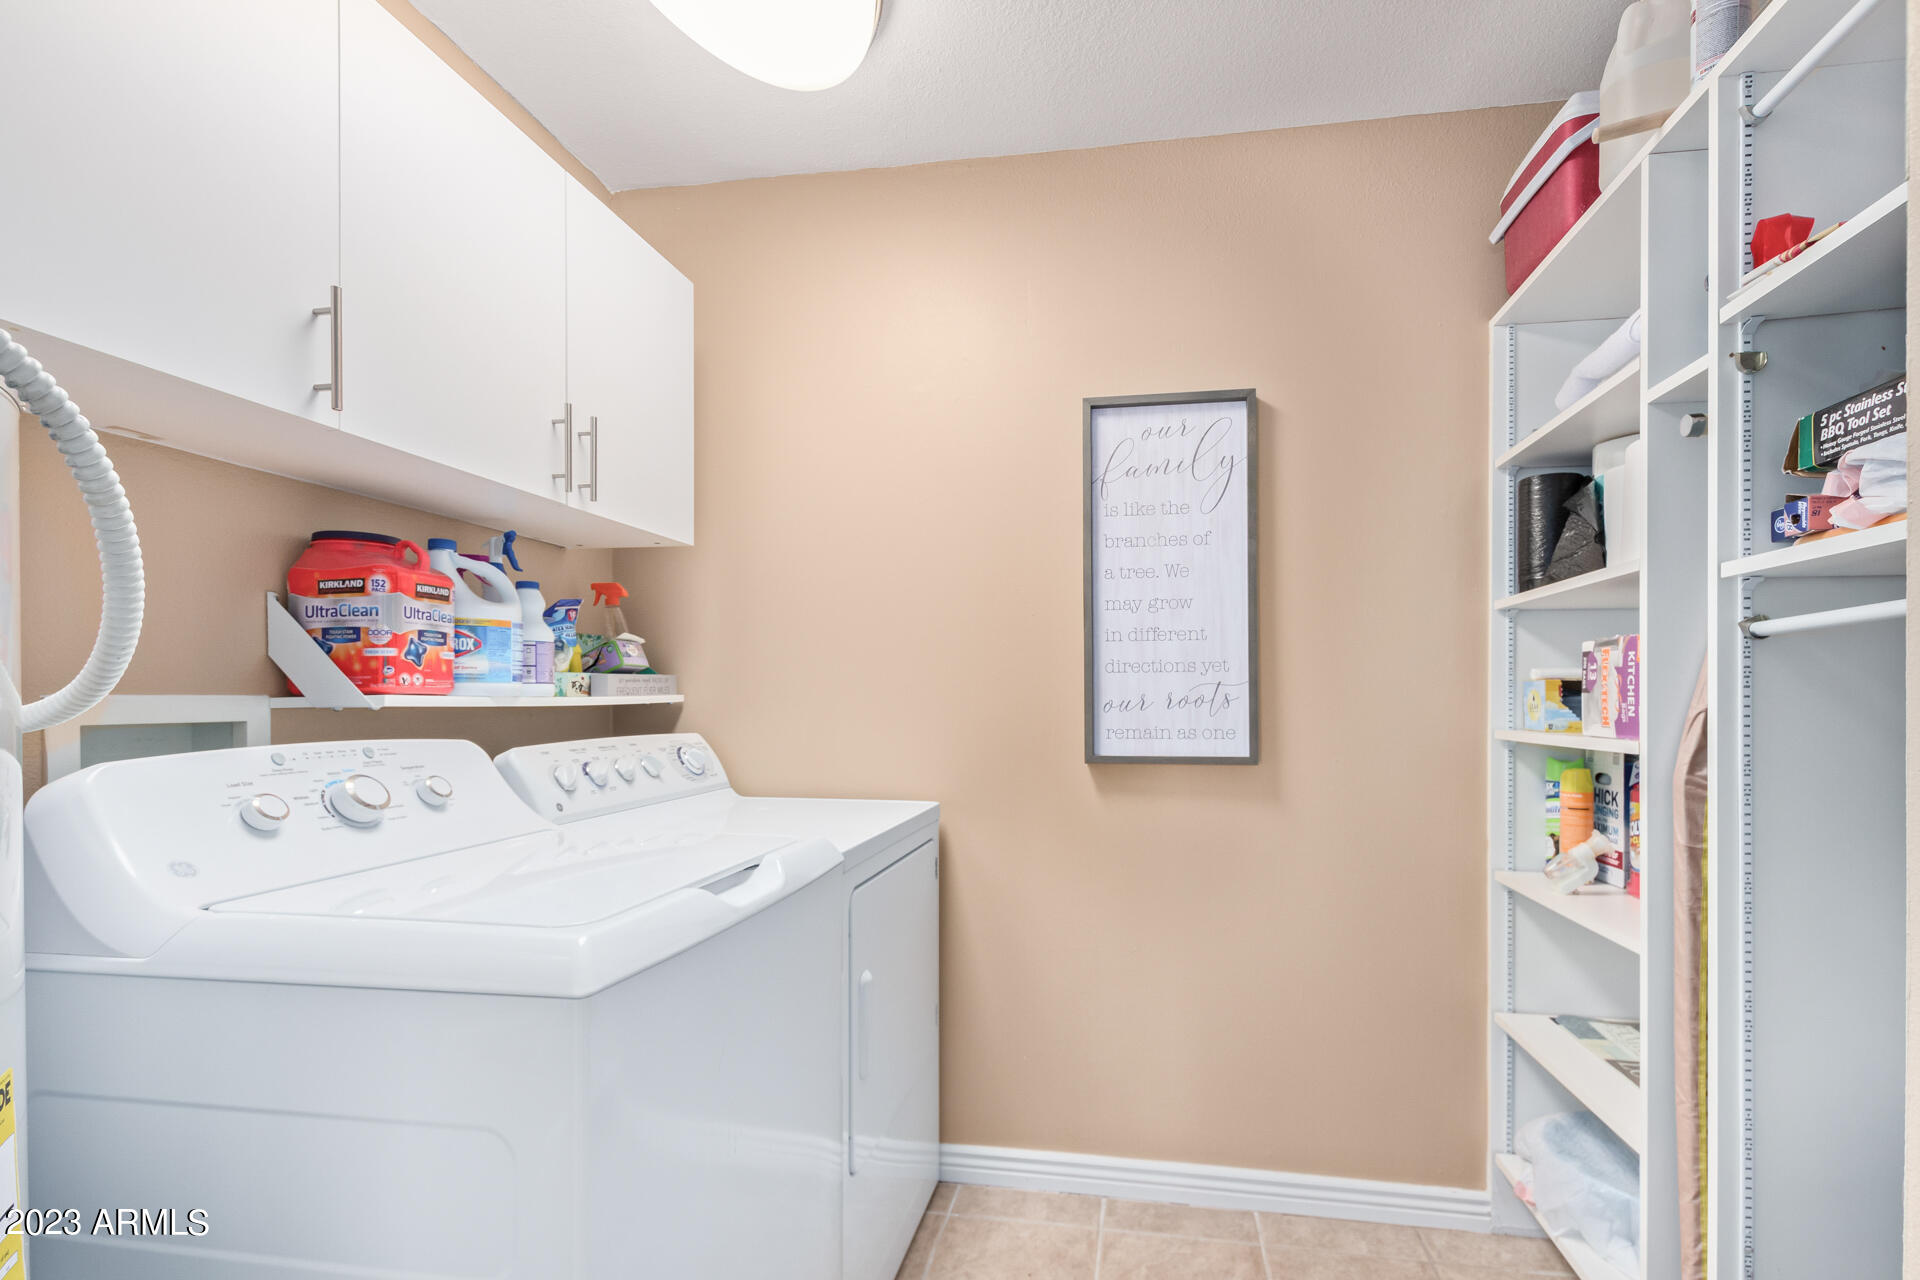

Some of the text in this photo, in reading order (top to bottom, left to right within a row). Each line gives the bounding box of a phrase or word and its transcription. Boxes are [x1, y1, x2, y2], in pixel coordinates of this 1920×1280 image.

[1820, 413, 1828, 427] 5
[1829, 410, 1842, 426] pc
[1843, 389, 1894, 417] Stainless
[1141, 418, 1196, 440] our
[1820, 404, 1892, 442] BBQ Tool Set
[1091, 417, 1248, 514] family
[1103, 501, 1192, 517] is like the
[1104, 530, 1212, 549] branches of
[1104, 563, 1190, 580] a tree. We
[319, 580, 364, 589] KIRKLAND
[371, 579, 386, 588] 152
[416, 584, 450, 597] KIRKLAND
[305, 603, 379, 618] UltraClean
[404, 605, 456, 623] UltraClea
[1104, 598, 1193, 614] may grow
[1105, 626, 1208, 642] in different
[455, 638, 475, 651] ROX
[1105, 659, 1230, 676] directions yet
[1588, 663, 1597, 681] 13
[1627, 651, 1635, 717] KITCHEN
[1103, 681, 1248, 717] our roots
[1105, 726, 1237, 740] remain as one
[1594, 786, 1619, 808] HICK
